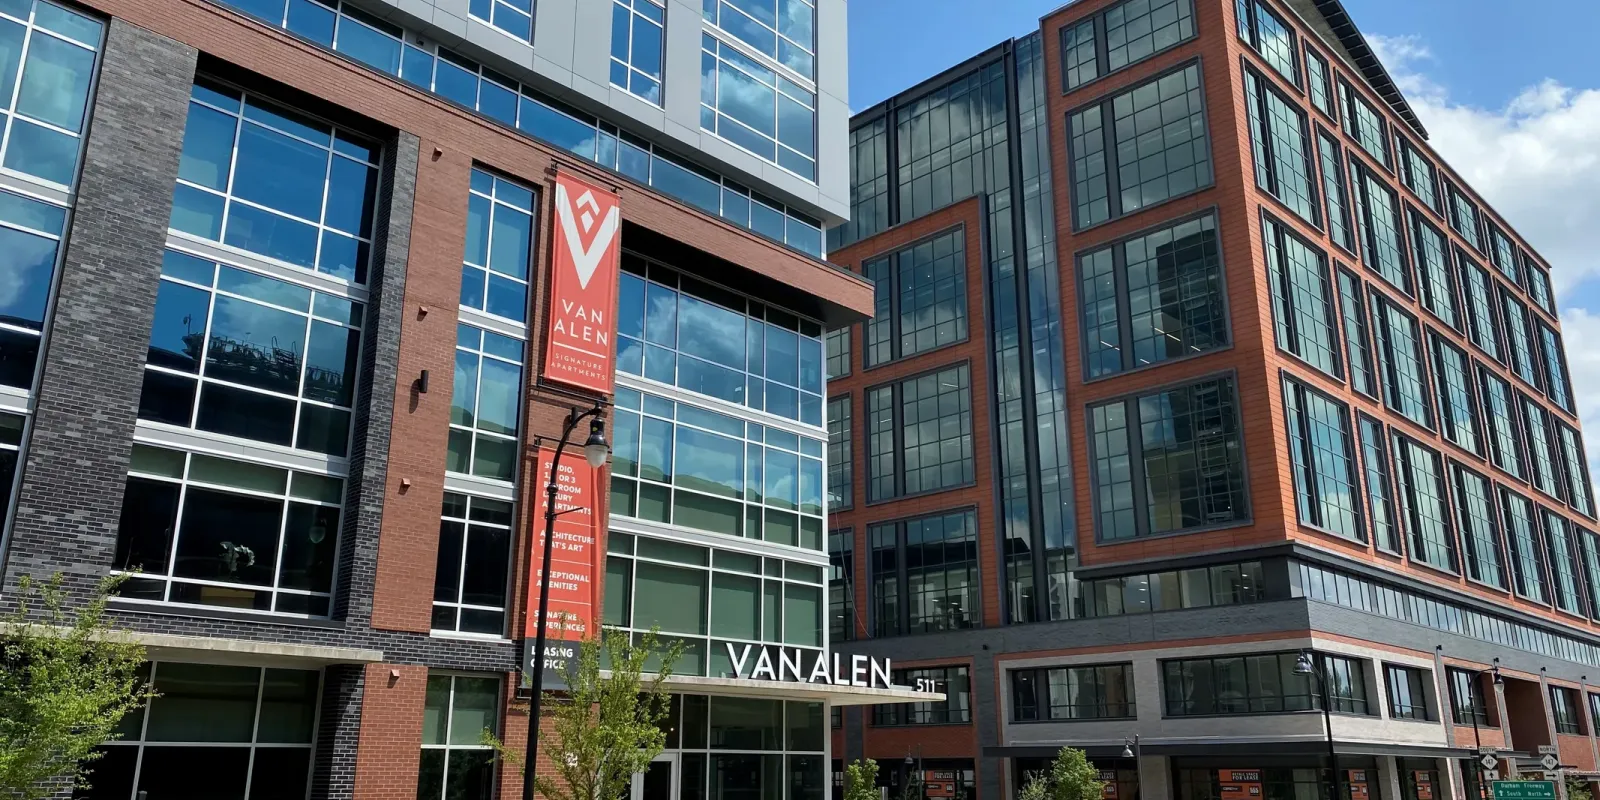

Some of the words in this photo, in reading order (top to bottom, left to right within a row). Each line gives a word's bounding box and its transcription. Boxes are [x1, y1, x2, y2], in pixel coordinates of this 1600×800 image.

[562, 298, 603, 325] VAN
[553, 318, 608, 347] ALEN
[555, 352, 603, 371] SIGNATURE
[551, 361, 607, 381] APARTMENTS
[544, 461, 575, 475] STDIO,
[558, 474, 570, 483] OR
[571, 476, 576, 484] 3
[541, 500, 592, 515] AARTMENTS
[539, 529, 595, 545] ACHITECTURE
[539, 539, 567, 550] TAT'S
[567, 544, 584, 552] ART
[536, 569, 590, 583] ECEPTIONAL
[535, 579, 578, 591] AENITIES
[531, 645, 574, 658] LASING
[725, 642, 802, 682] VAN
[808, 650, 891, 689] ALEN
[916, 678, 935, 693] 511
